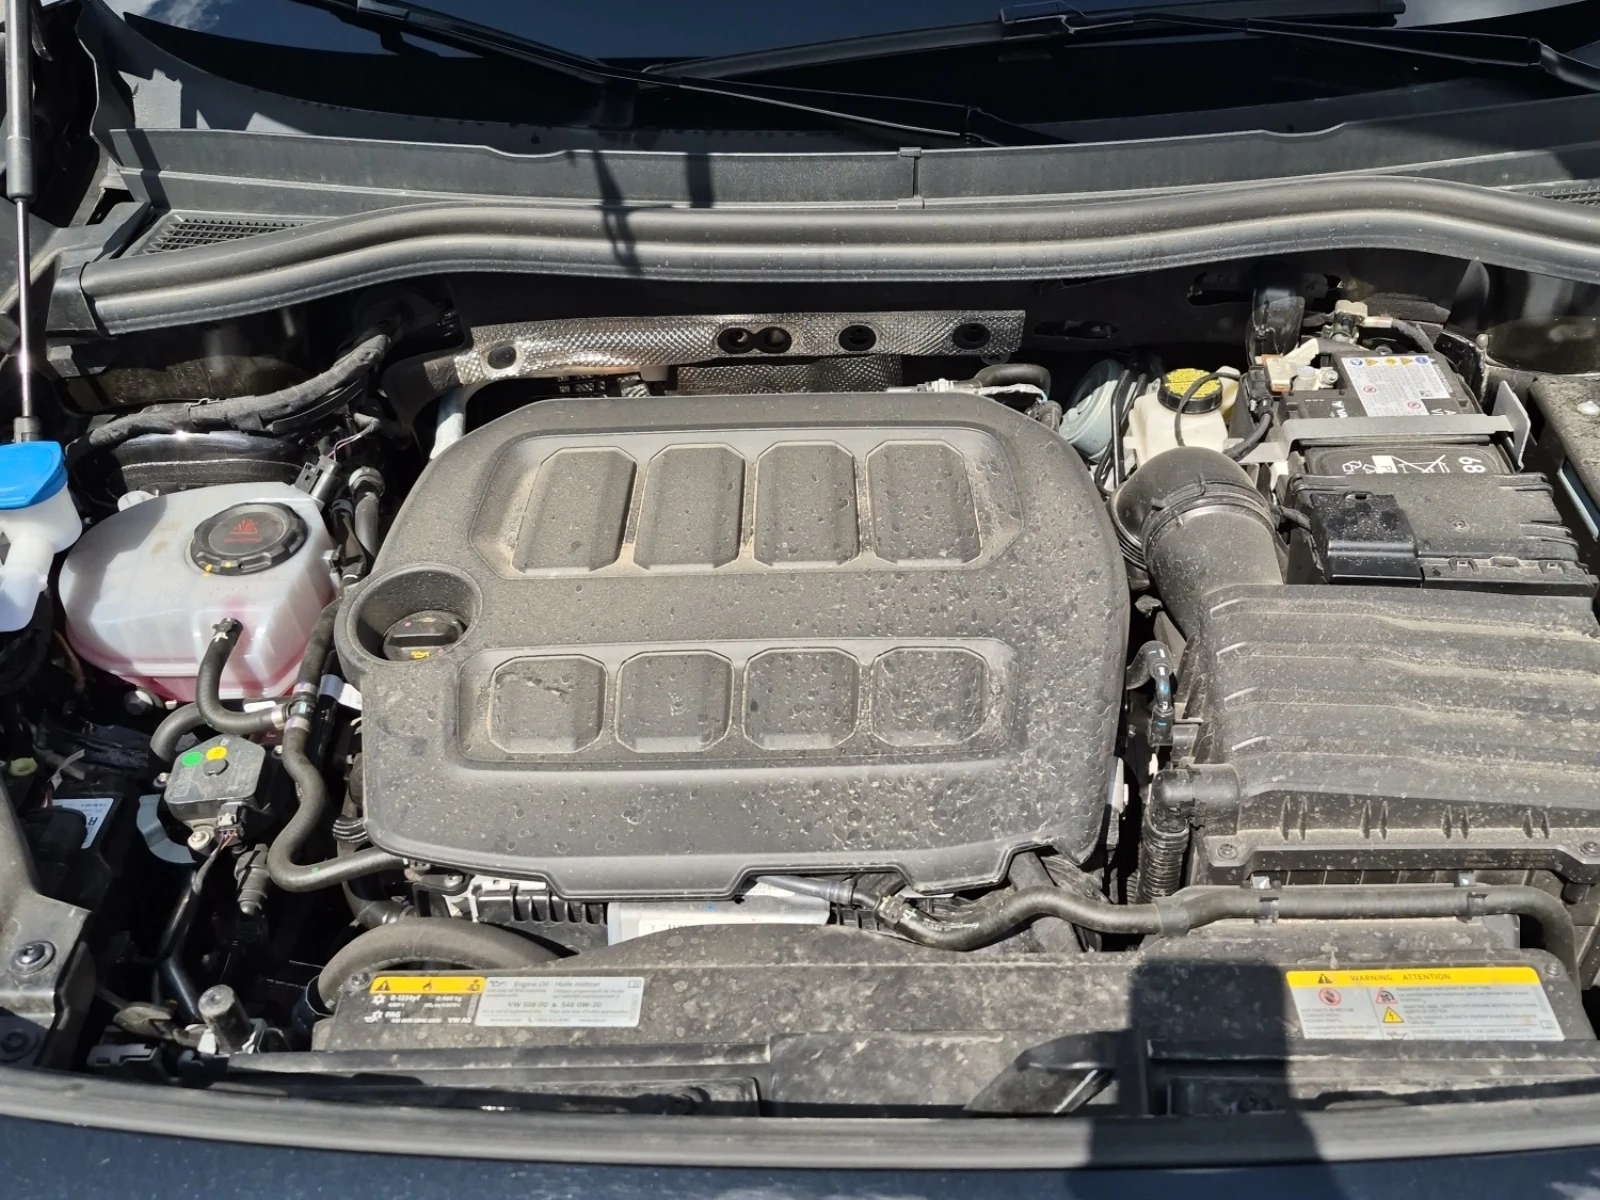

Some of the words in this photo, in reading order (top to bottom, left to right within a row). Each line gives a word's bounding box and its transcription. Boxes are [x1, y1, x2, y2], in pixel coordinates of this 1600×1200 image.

[1459, 457, 1486, 473] 68
[1402, 973, 1452, 981] ATTENTION
[513, 980, 537, 989] Engine
